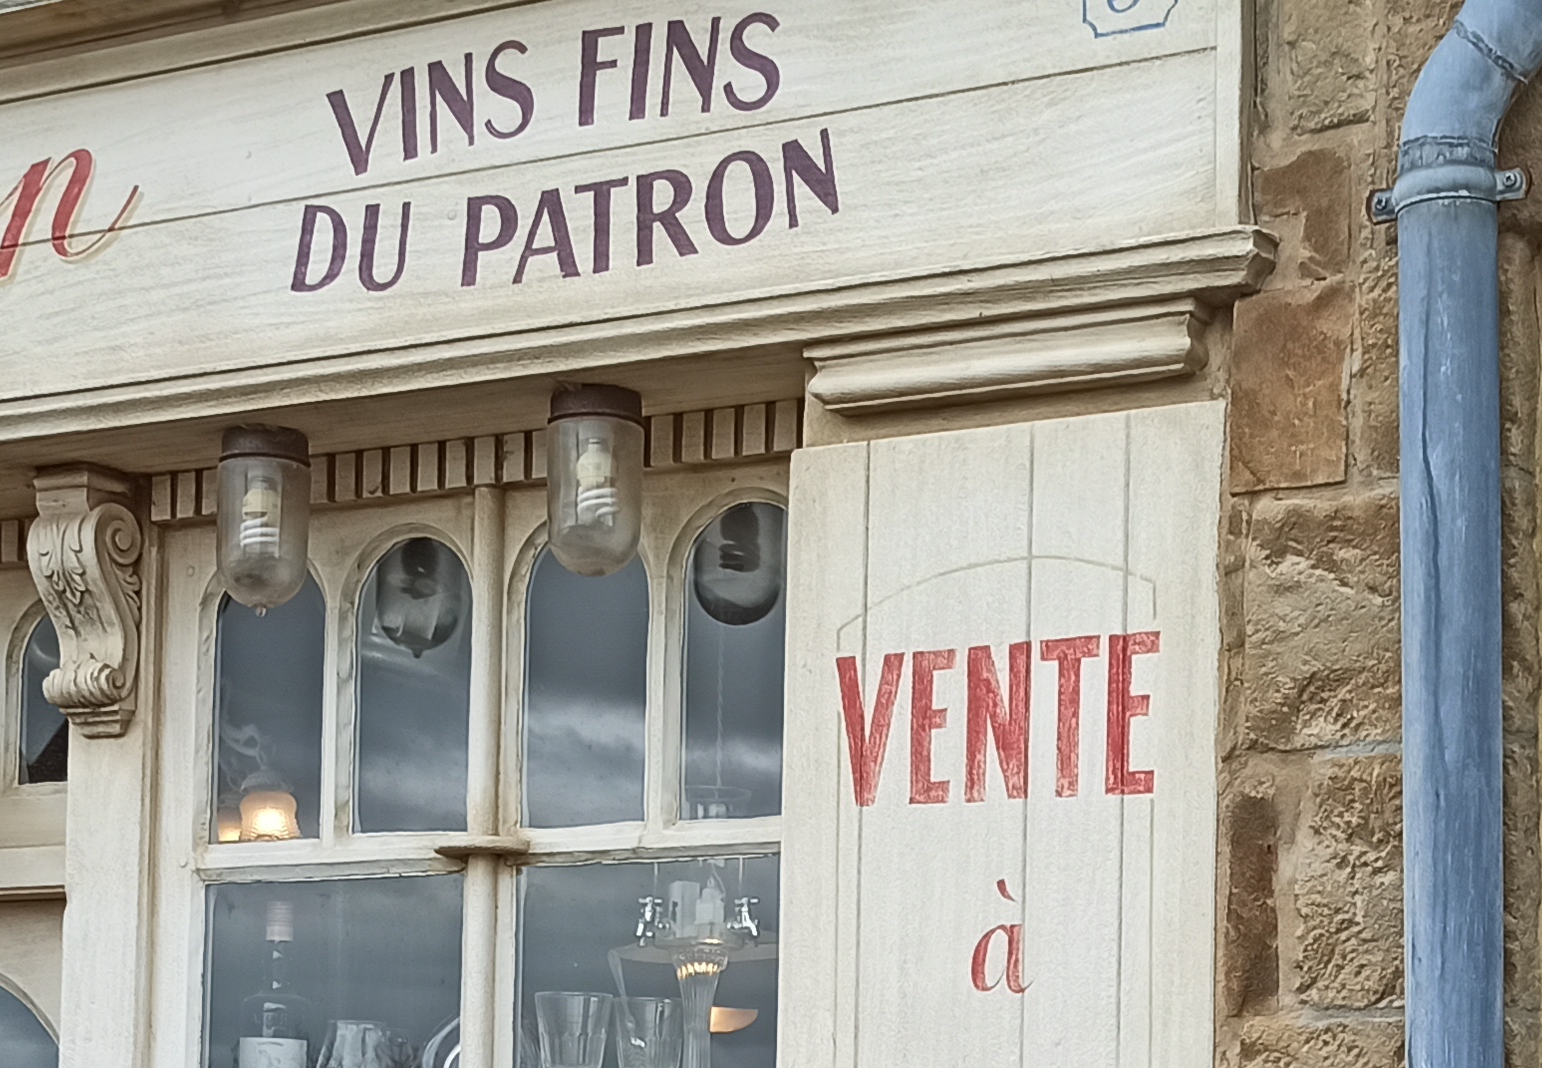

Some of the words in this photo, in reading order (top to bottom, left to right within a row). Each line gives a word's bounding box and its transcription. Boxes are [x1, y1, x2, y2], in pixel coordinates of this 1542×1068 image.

[325, 39, 535, 177] VINS
[577, 11, 782, 128] FINS
[290, 200, 412, 294] DU
[460, 128, 842, 288] PATRON
[836, 630, 1161, 808] VENTE
[970, 877, 1036, 994] à
